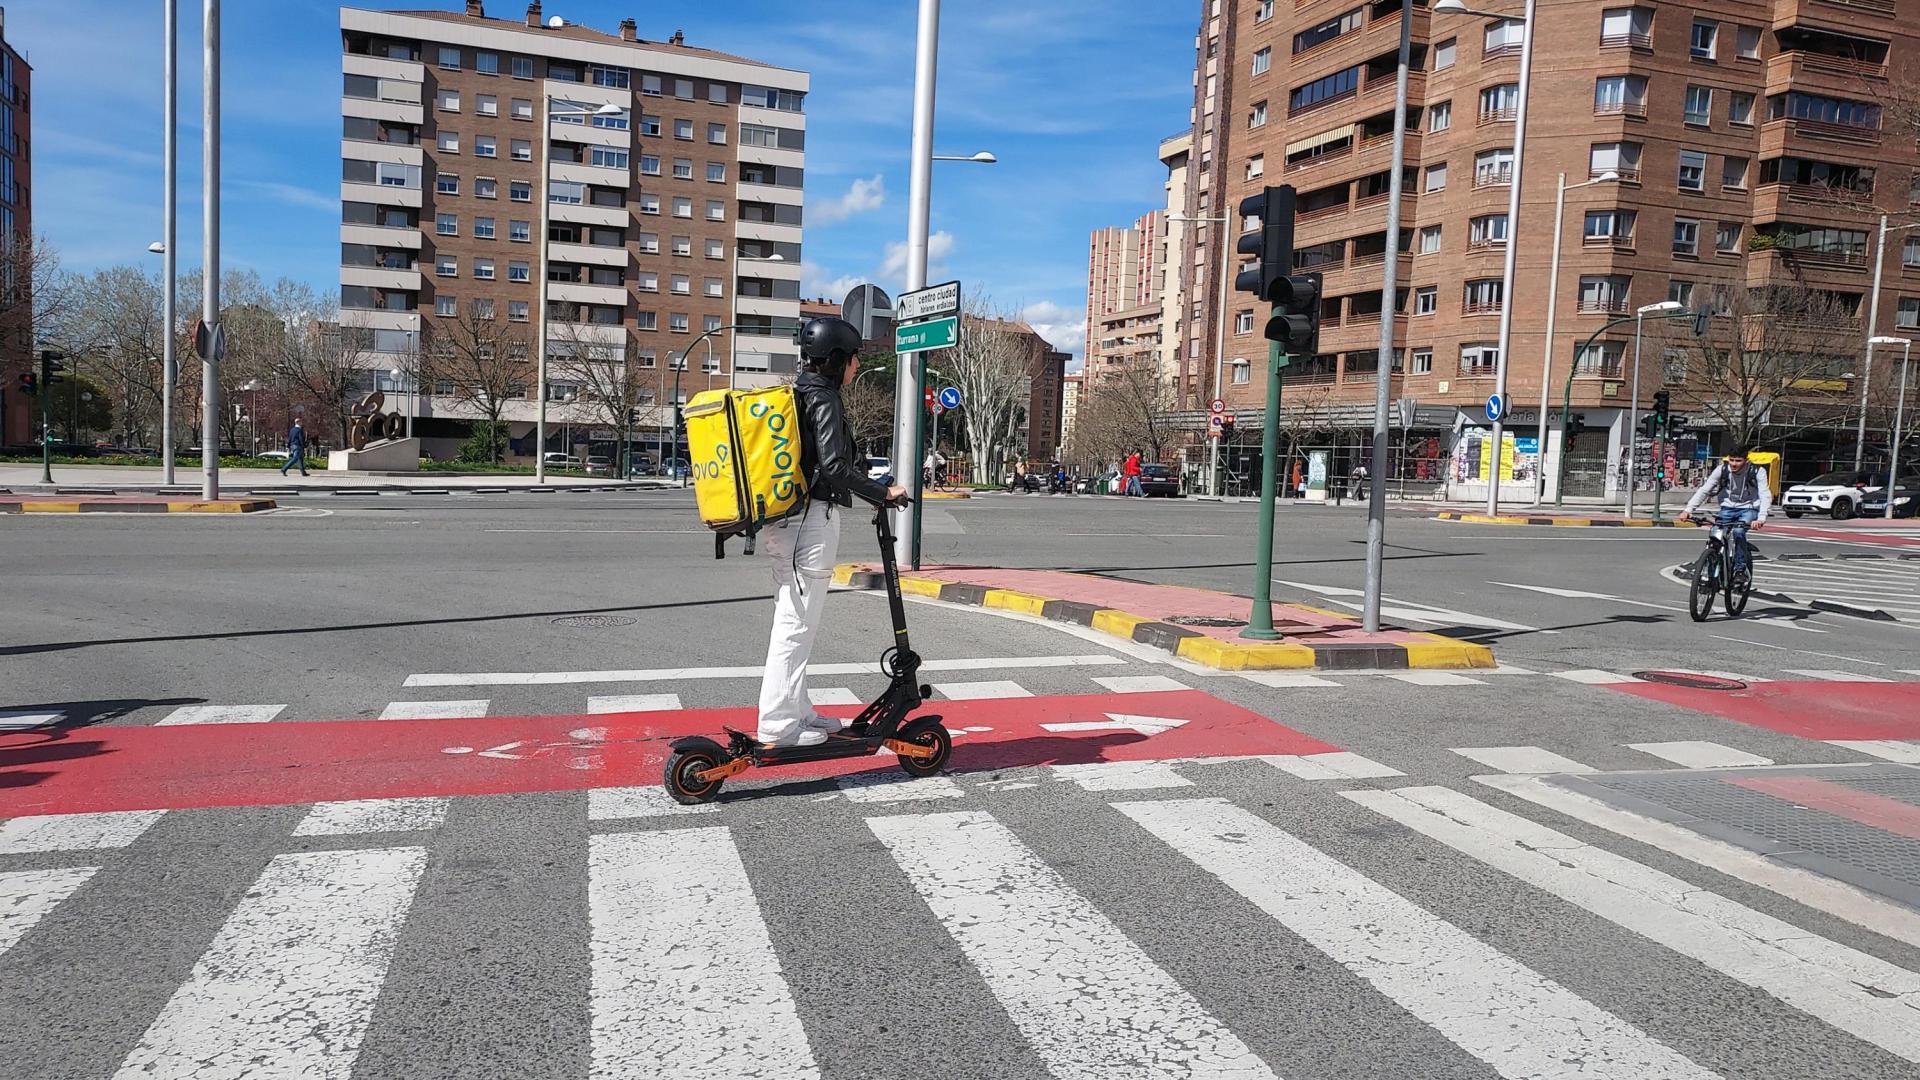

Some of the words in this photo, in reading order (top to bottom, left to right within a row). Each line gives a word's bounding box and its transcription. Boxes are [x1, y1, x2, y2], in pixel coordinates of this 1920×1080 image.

[918, 292, 936, 304] centro
[937, 286, 956, 300] ciudad
[768, 413, 796, 502] Glovo
